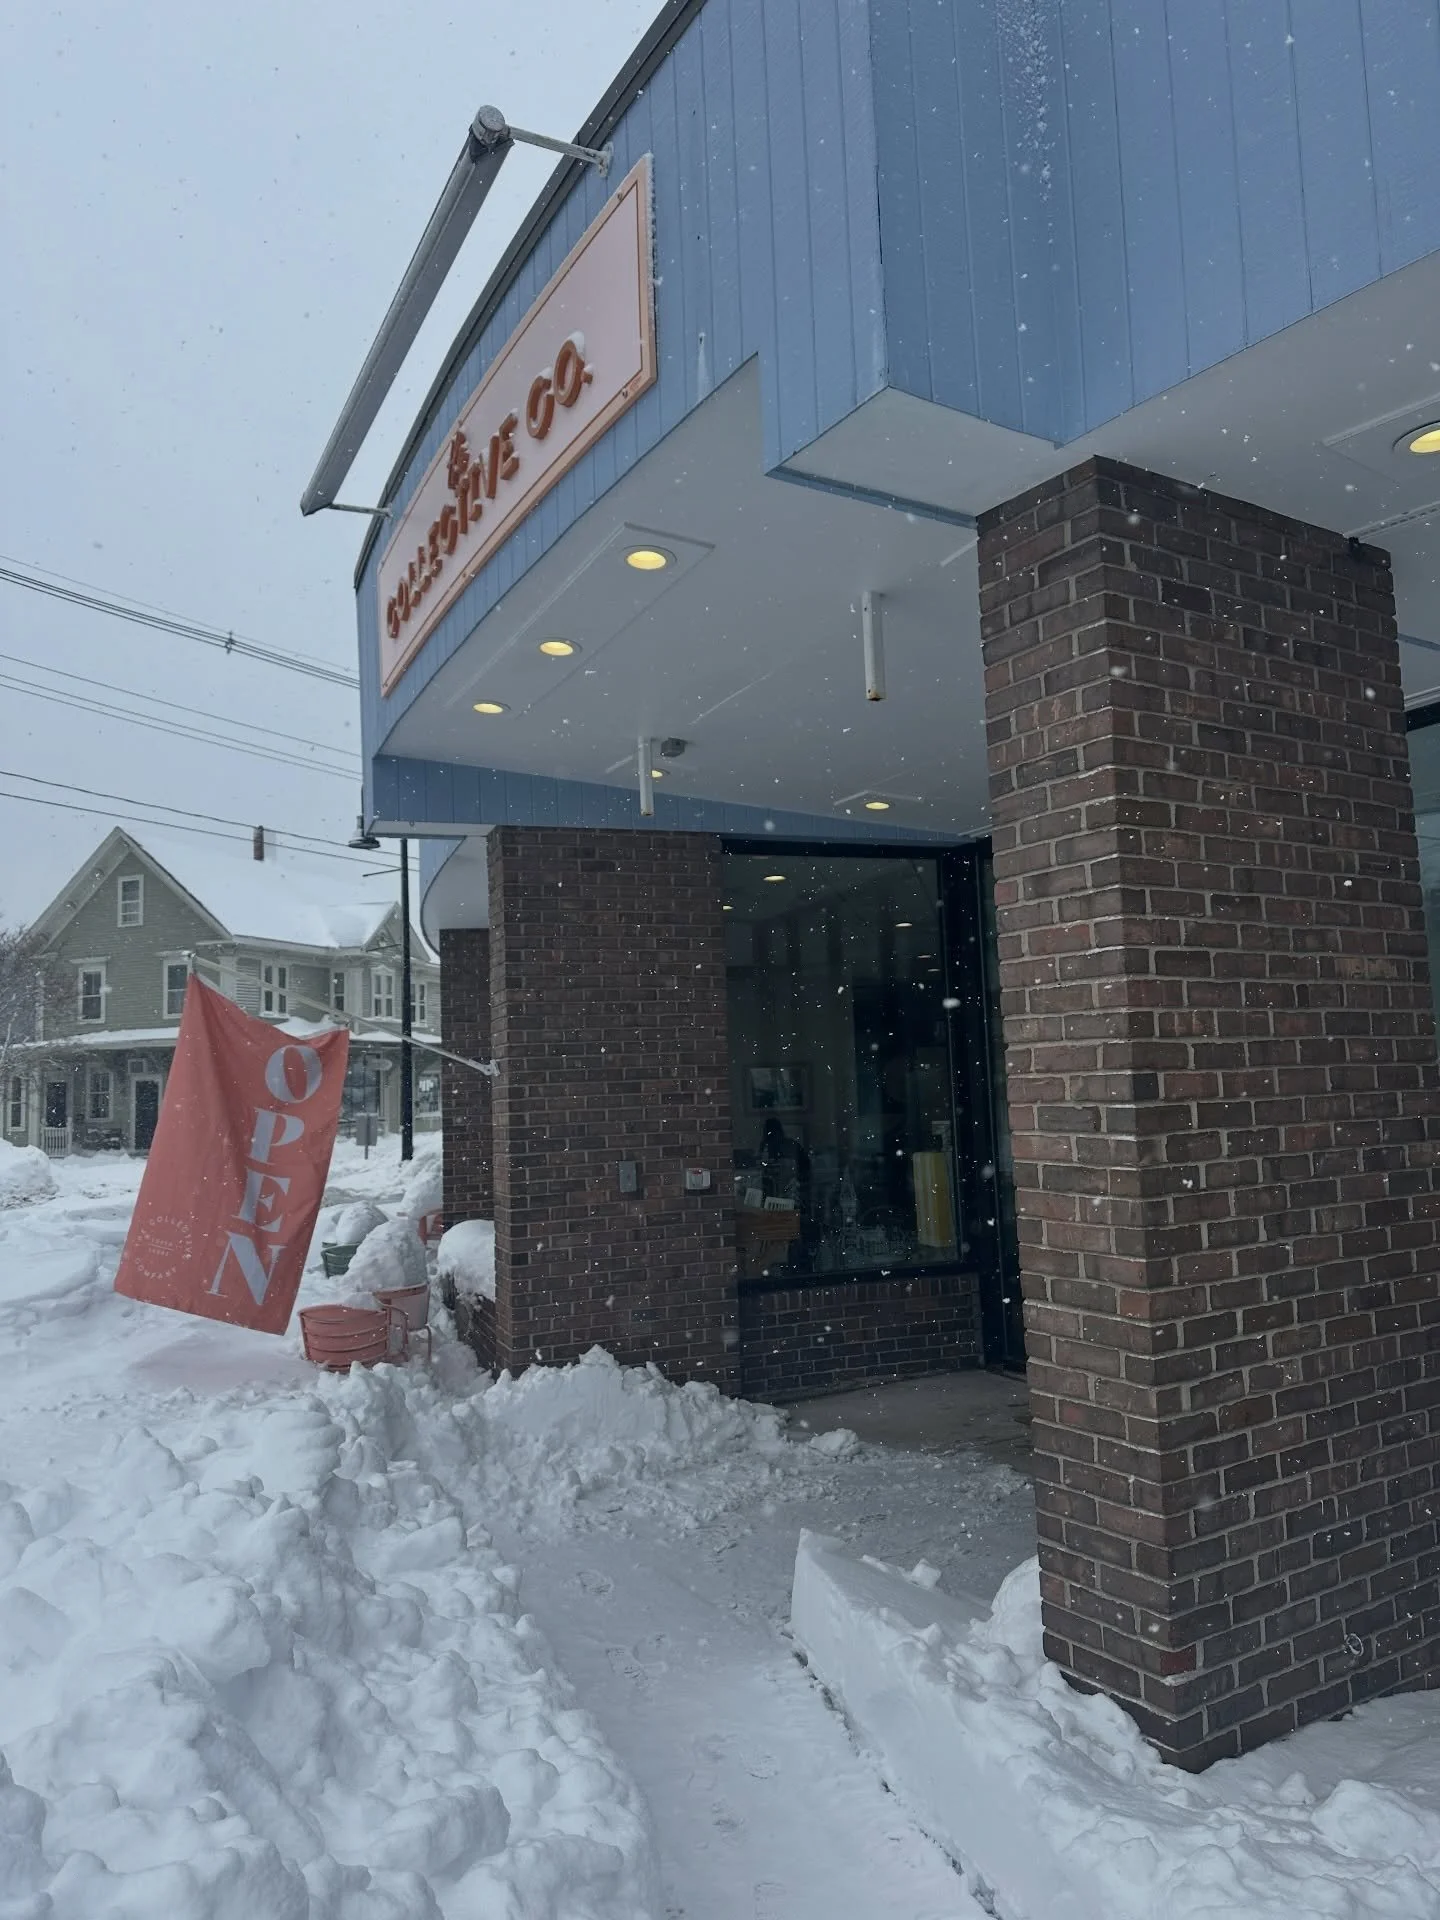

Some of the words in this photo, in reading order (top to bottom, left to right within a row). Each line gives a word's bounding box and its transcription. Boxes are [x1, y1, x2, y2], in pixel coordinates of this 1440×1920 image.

[386, 413, 520, 639] COLLECTIVE
[525, 339, 594, 440] CO.
[135, 1257, 177, 1280] COMPANY
[204, 1043, 323, 1306] OPEN
